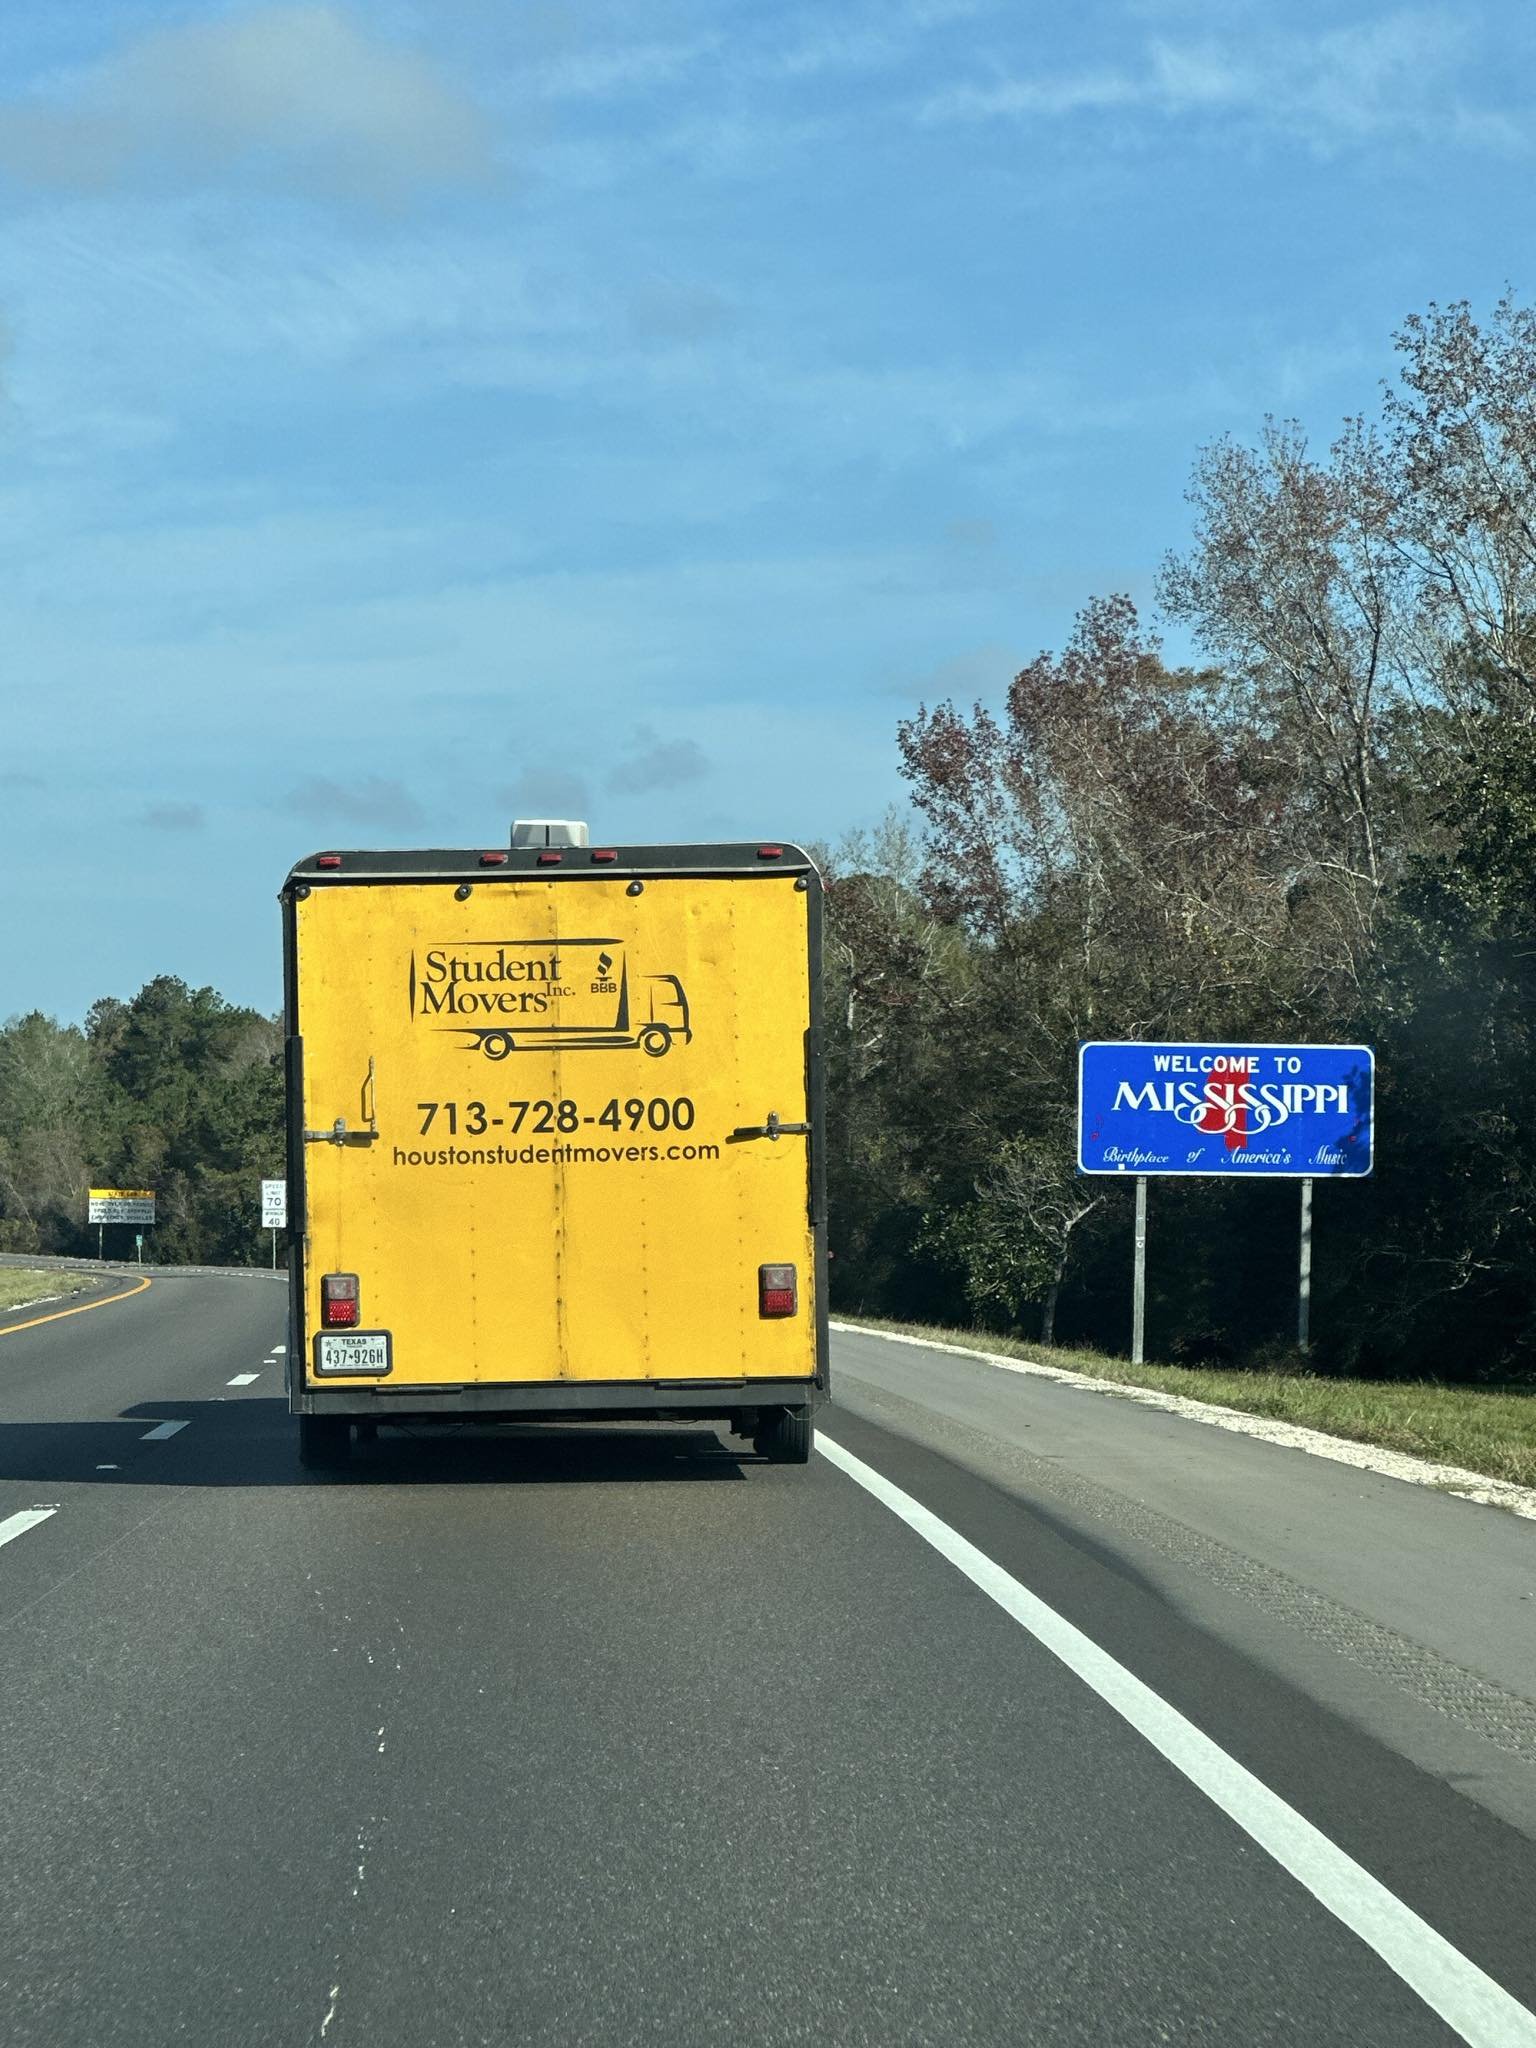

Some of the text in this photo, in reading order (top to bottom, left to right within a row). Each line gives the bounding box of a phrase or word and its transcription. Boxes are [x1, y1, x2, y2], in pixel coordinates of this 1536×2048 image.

[426, 949, 562, 983] Student
[420, 981, 548, 1014] Movers
[545, 982, 576, 997] Inc.
[590, 982, 618, 993] BBB
[1153, 1055, 1302, 1074] WELCOME TO
[417, 1097, 695, 1136] 713-728-4900
[1111, 1081, 1350, 1135] MISSISSIPPI
[393, 1144, 720, 1166] houstonstudentmovers.com
[1103, 1145, 1348, 1165] Birthplace of America's Music
[267, 1197, 282, 1206] 70
[268, 1217, 280, 1226] 40
